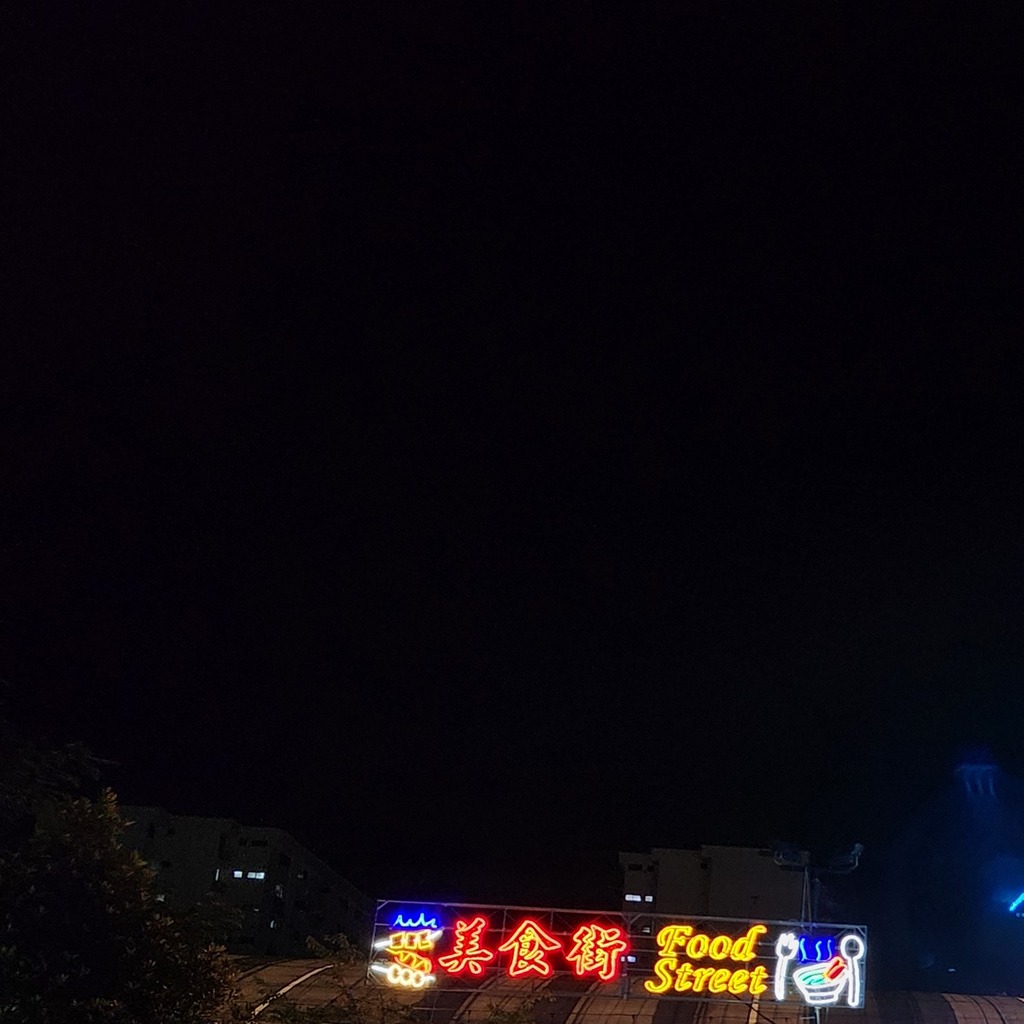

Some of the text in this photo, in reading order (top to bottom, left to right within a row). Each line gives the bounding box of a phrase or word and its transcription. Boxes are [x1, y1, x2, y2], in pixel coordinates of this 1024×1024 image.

[438, 916, 627, 982] 美食街
[656, 924, 768, 962] Food
[644, 957, 769, 995] Street
